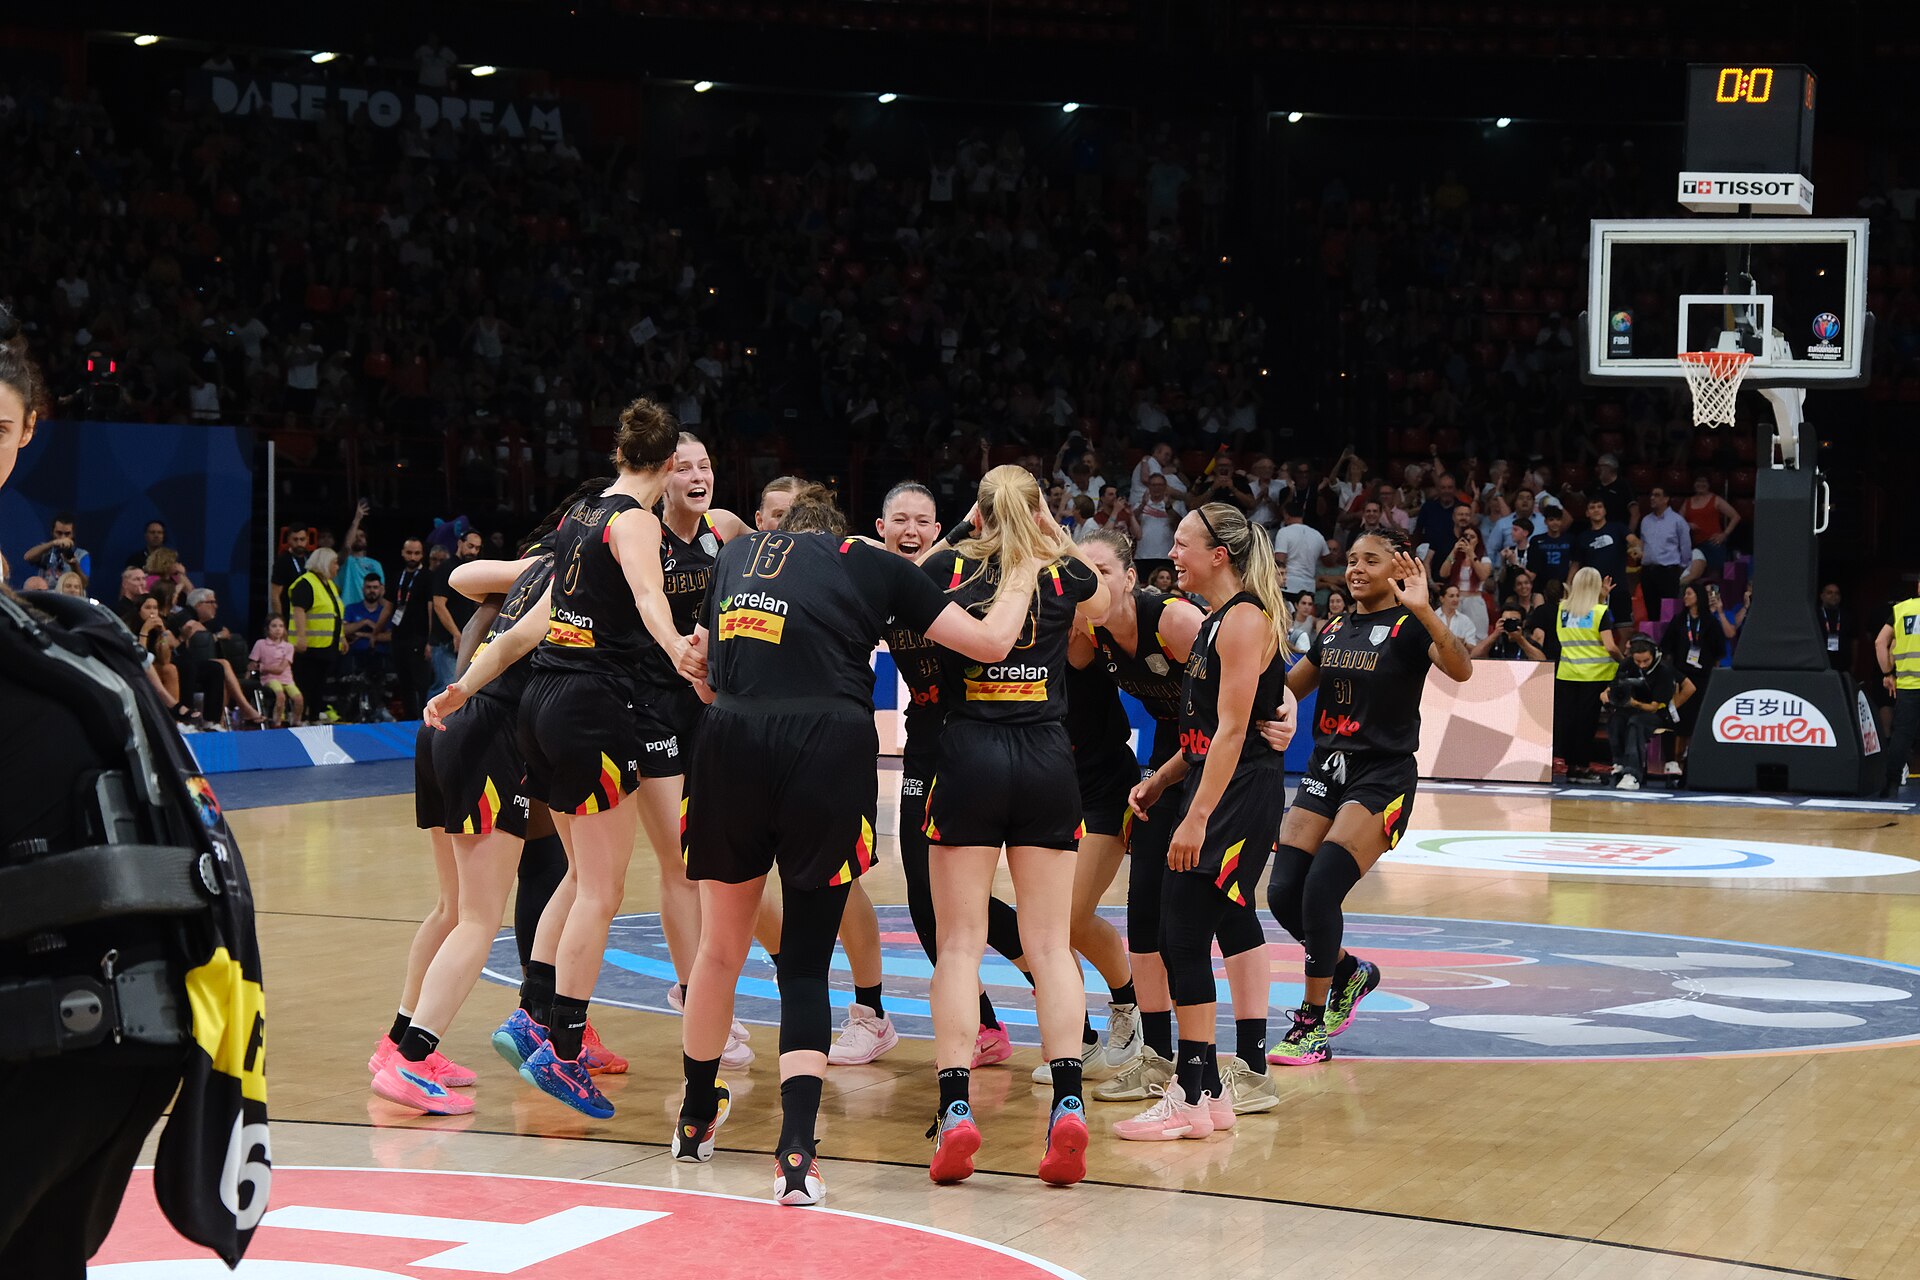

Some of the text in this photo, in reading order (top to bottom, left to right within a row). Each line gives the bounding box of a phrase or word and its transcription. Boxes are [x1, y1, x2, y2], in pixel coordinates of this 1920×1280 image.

[212, 76, 565, 142] DARE TO DREAM
[1714, 181, 1794, 196] TISSOT
[563, 535, 581, 597] 6
[742, 532, 794, 580] 13
[664, 565, 713, 594] BELGI
[733, 591, 789, 616] crelan
[725, 616, 769, 633] DHL
[986, 663, 1049, 680] crelan
[1333, 677, 1352, 705] 31
[1735, 697, 1804, 718] 百岁山
